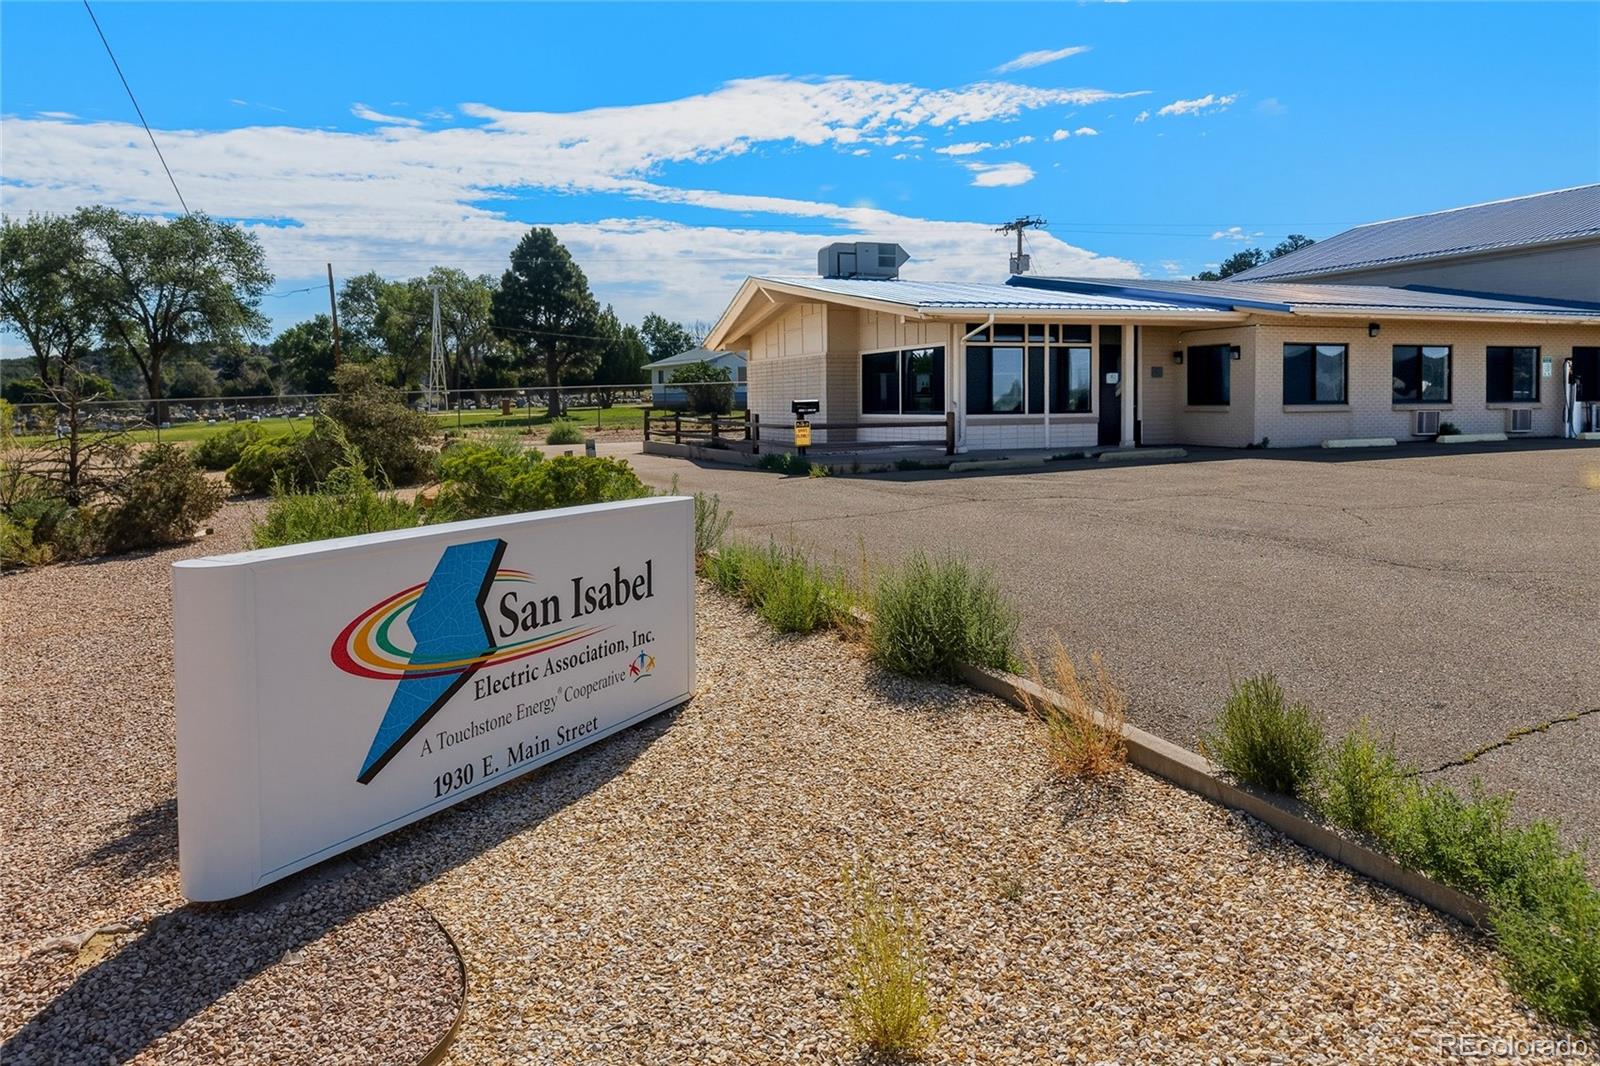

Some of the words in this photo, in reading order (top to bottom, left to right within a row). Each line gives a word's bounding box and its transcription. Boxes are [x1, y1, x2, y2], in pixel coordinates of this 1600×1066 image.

[499, 592, 561, 638] San
[571, 559, 654, 619] Isabel
[474, 667, 539, 701] Electric
[543, 642, 629, 678] Association,
[632, 629, 655, 647] Inc.
[420, 738, 433, 757] A
[436, 711, 513, 751] Touchstone
[564, 670, 626, 702] Cooperative
[434, 764, 474, 798] 1930
[482, 756, 499, 778] E.
[507, 737, 550, 767] Main
[557, 716, 599, 746] Street
